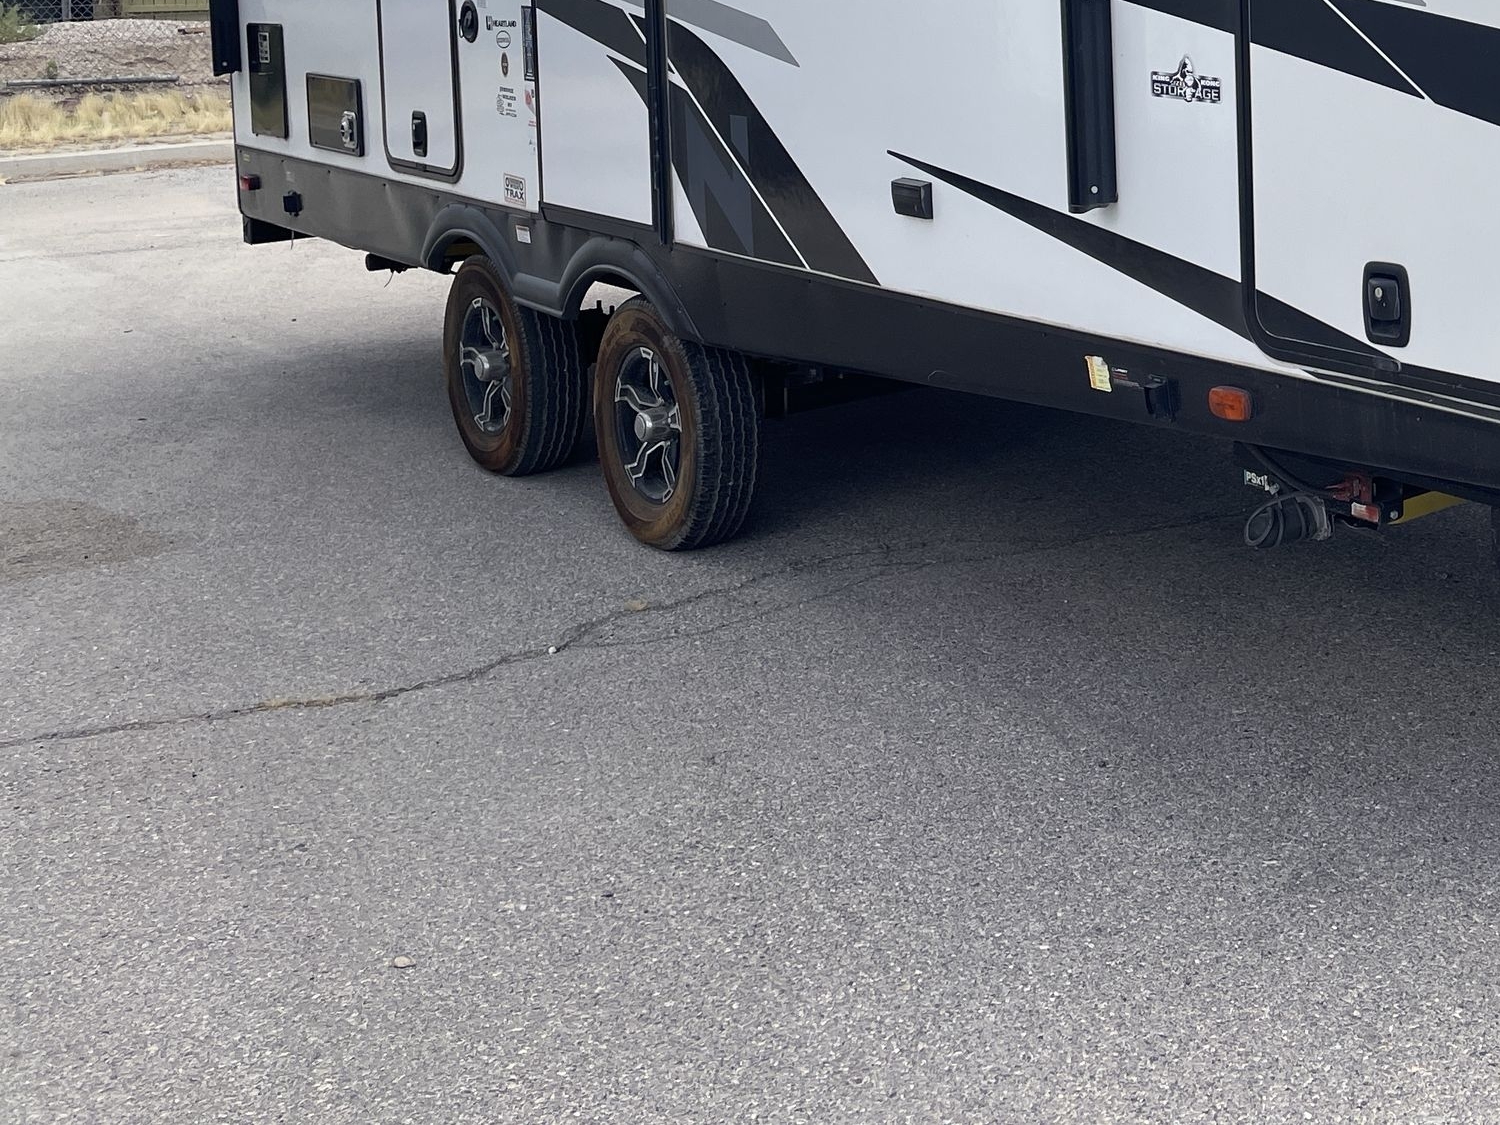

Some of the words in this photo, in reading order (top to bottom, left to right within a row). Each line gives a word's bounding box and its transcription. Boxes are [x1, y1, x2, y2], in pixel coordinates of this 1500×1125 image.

[493, 19, 517, 28] HEARTLAND
[1152, 74, 1170, 82] KING
[1200, 79, 1220, 87] KONG
[1153, 82, 1219, 101] STORAGE
[505, 187, 525, 201] TRAX
